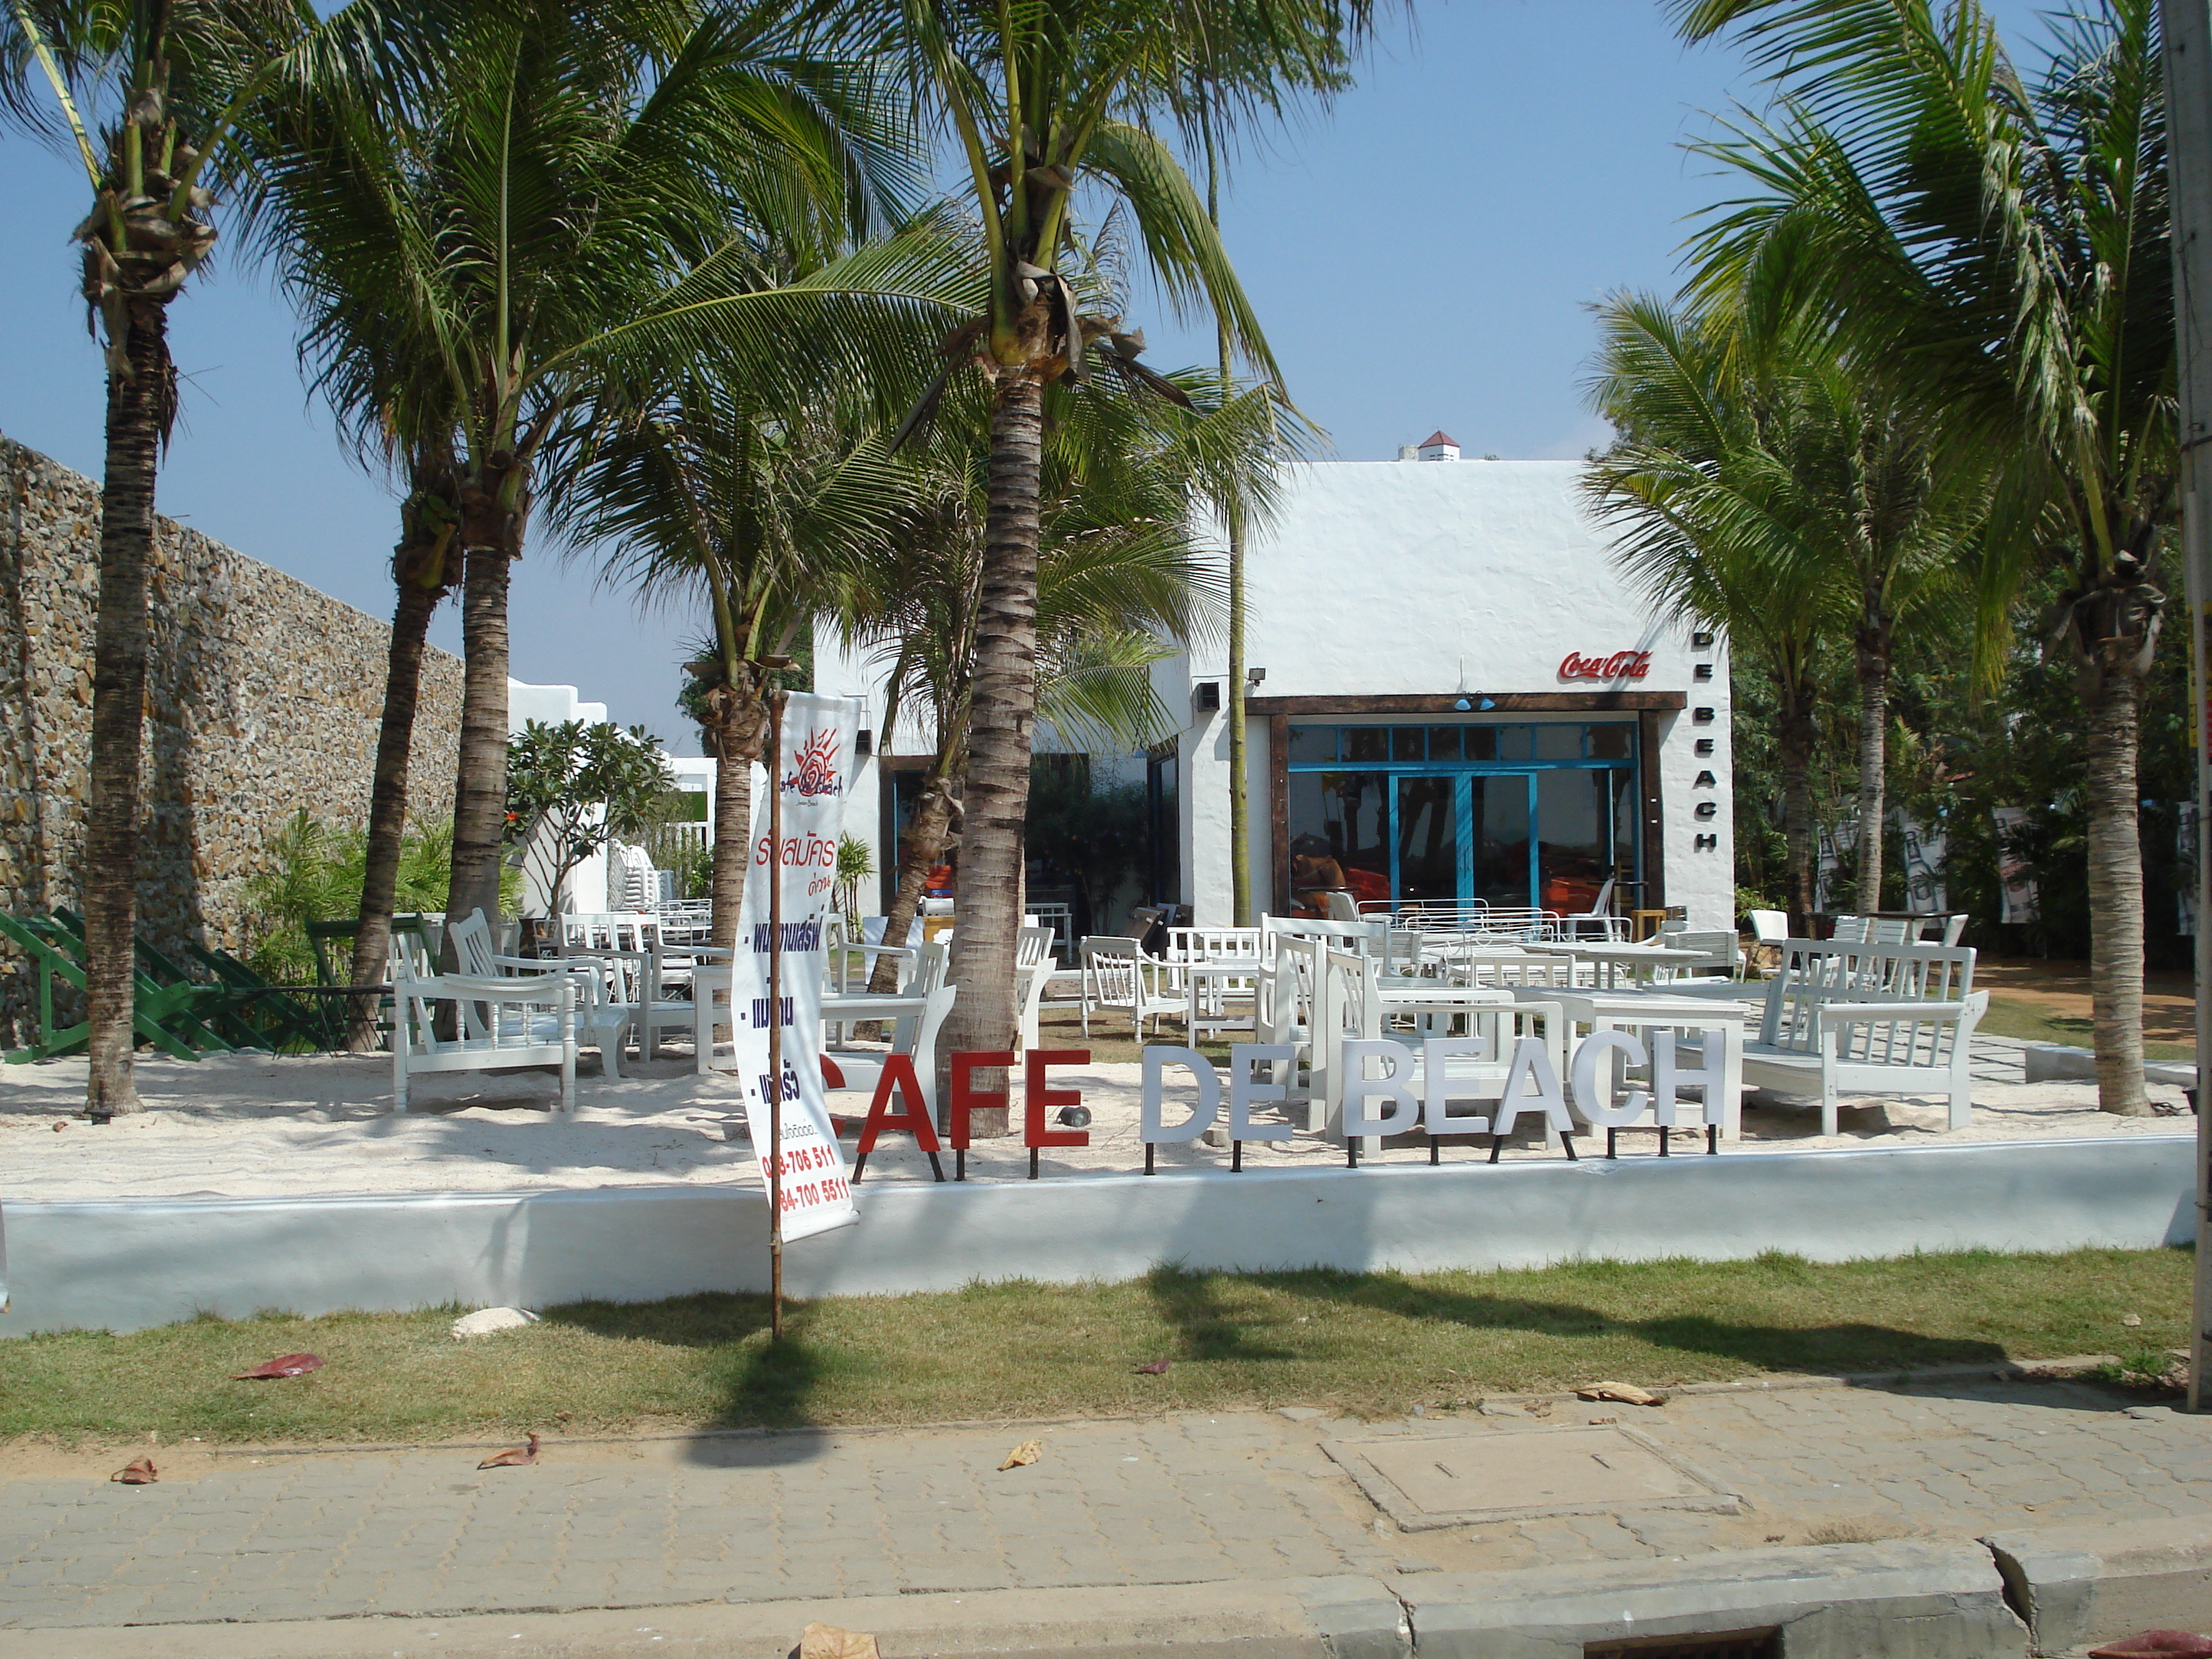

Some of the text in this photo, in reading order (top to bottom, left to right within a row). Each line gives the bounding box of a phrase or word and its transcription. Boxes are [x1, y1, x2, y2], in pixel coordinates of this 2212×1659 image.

[780, 770, 795, 796] afe
[1695, 707, 1717, 848] BEACH
[1141, 1043, 1295, 1143] DE
[1341, 1030, 1725, 1137] BEACH
[762, 1144, 835, 1179] 08-706 511
[780, 1176, 849, 1212] 84-700 5511
